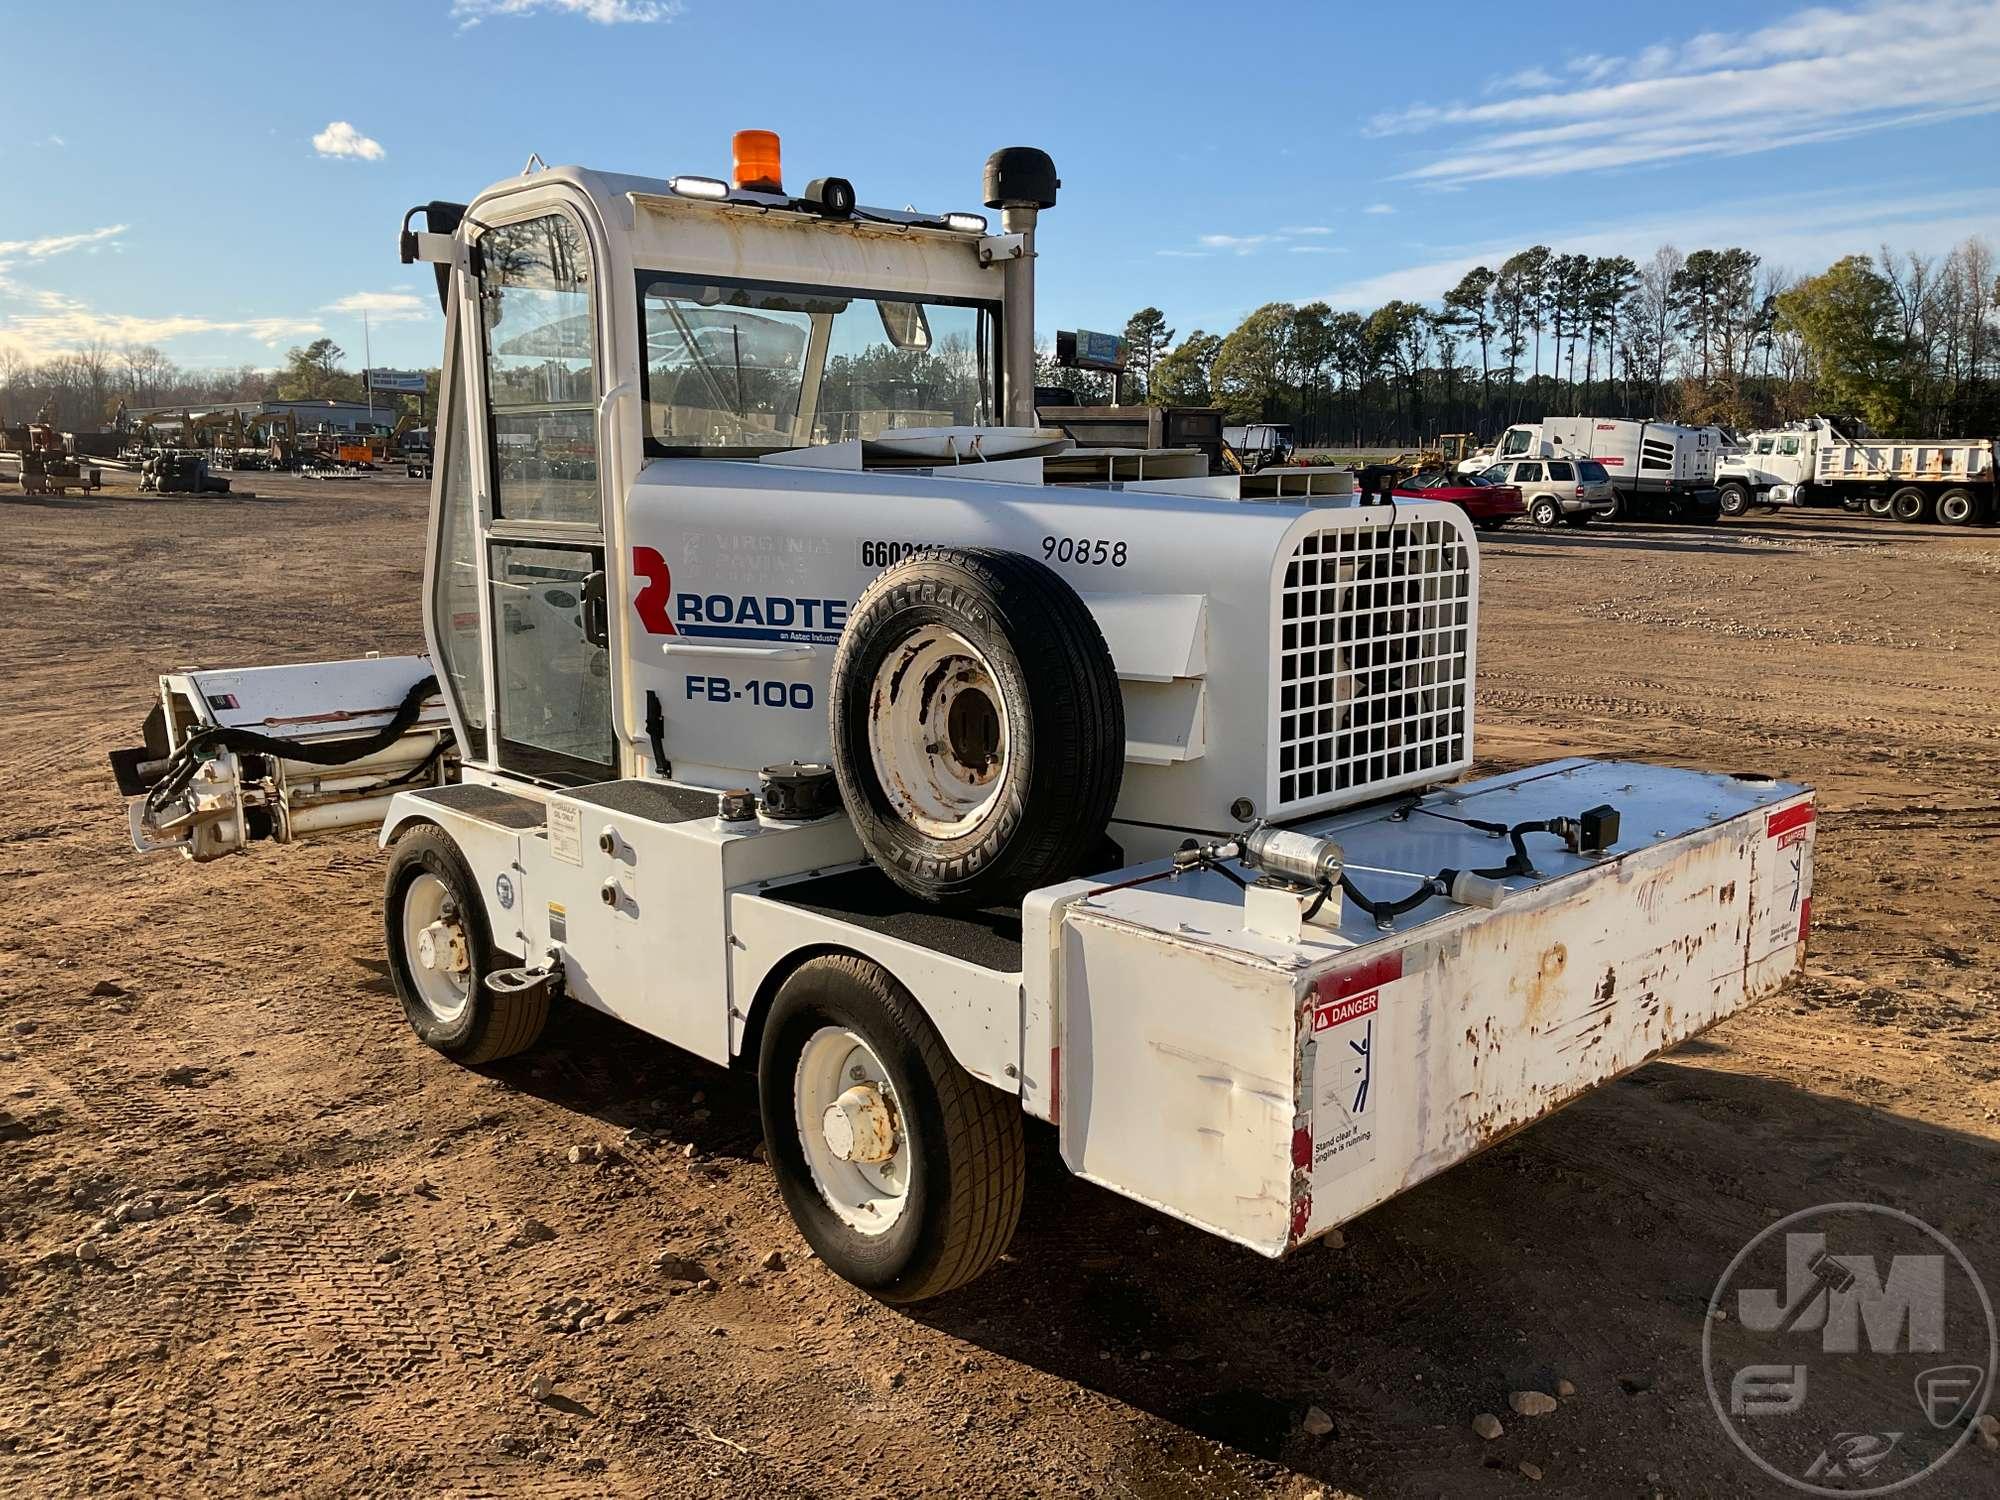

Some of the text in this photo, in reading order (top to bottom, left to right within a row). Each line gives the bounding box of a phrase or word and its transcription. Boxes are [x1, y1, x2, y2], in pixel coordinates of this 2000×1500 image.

[1040, 535, 1128, 567] 90858
[676, 593, 857, 630] ROADTE
[790, 632, 810, 641] Astec
[686, 675, 813, 709] FB-100
[885, 811, 1013, 882] CARLISLE
[1332, 995, 1377, 1023] DANGER
[1315, 1137, 1334, 1153] Stand
[1335, 1130, 1352, 1143] clear
[1315, 1147, 1338, 1164] engine
